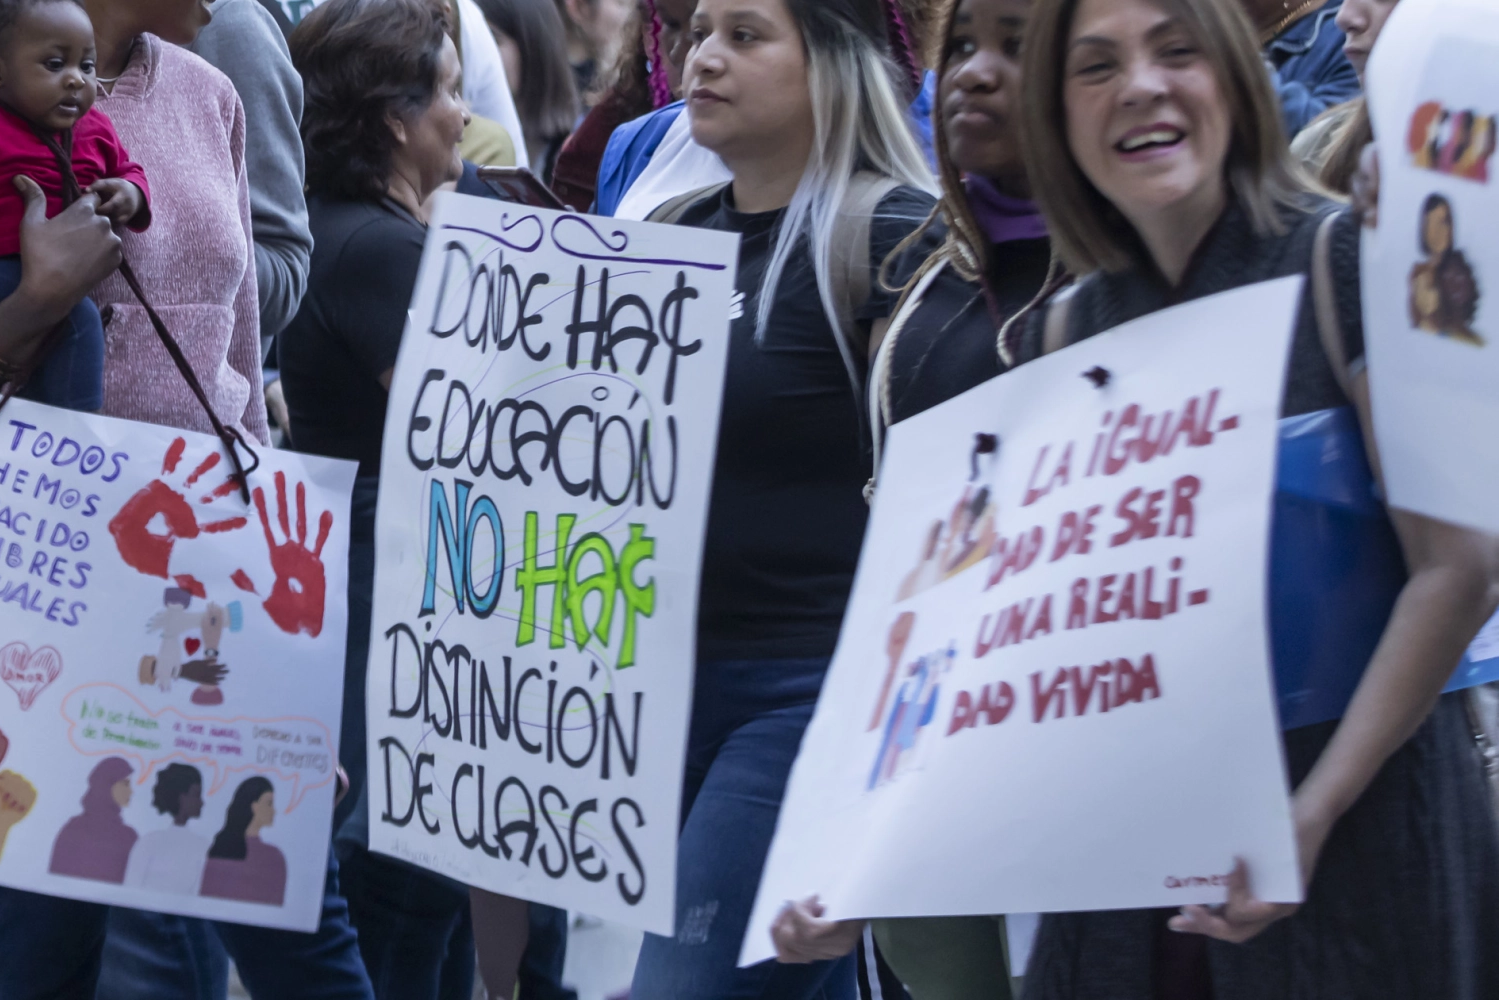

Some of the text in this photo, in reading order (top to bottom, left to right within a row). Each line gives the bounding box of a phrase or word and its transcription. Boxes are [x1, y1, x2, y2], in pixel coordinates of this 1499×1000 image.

[8, 418, 130, 483] TODOS
[406, 366, 678, 510] EDUCACiÓN
[1018, 441, 1075, 507] LA
[416, 477, 506, 620] NO
[1046, 503, 1105, 564] DE
[1107, 474, 1202, 549] SER
[972, 592, 1054, 660] UNA
[383, 619, 644, 781] DiSTINCiÓN
[944, 652, 1163, 738] DAD ViViDA
[378, 735, 646, 906] DE CLASES
